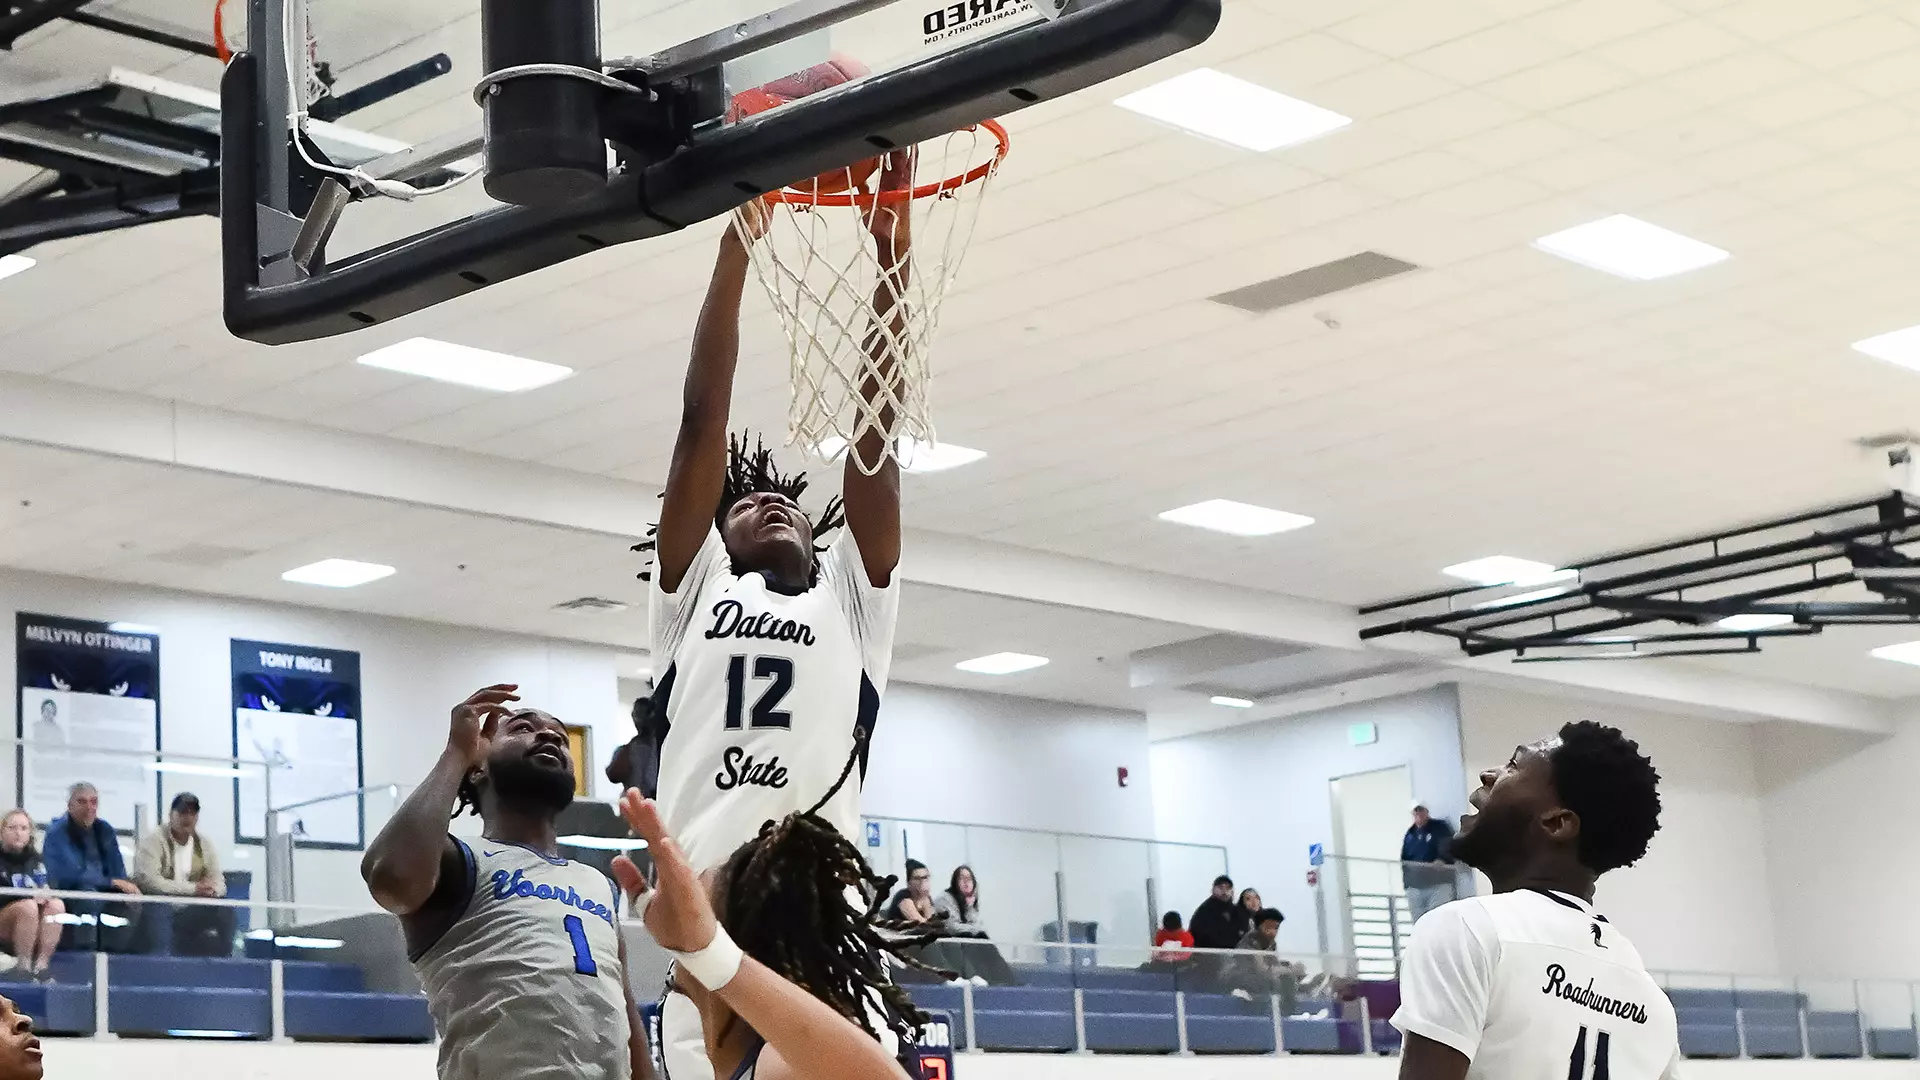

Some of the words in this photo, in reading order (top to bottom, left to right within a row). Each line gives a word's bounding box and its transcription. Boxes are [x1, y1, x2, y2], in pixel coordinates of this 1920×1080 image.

[25, 624, 83, 645] MELVYN
[84, 631, 152, 653] OTTINGER
[705, 600, 816, 646] Dalton
[259, 650, 295, 670] TONY
[295, 655, 333, 674] INGLE
[723, 653, 796, 731] 12
[715, 746, 789, 790] State
[563, 914, 598, 977] 1
[1542, 963, 1648, 1025] Roadrunners
